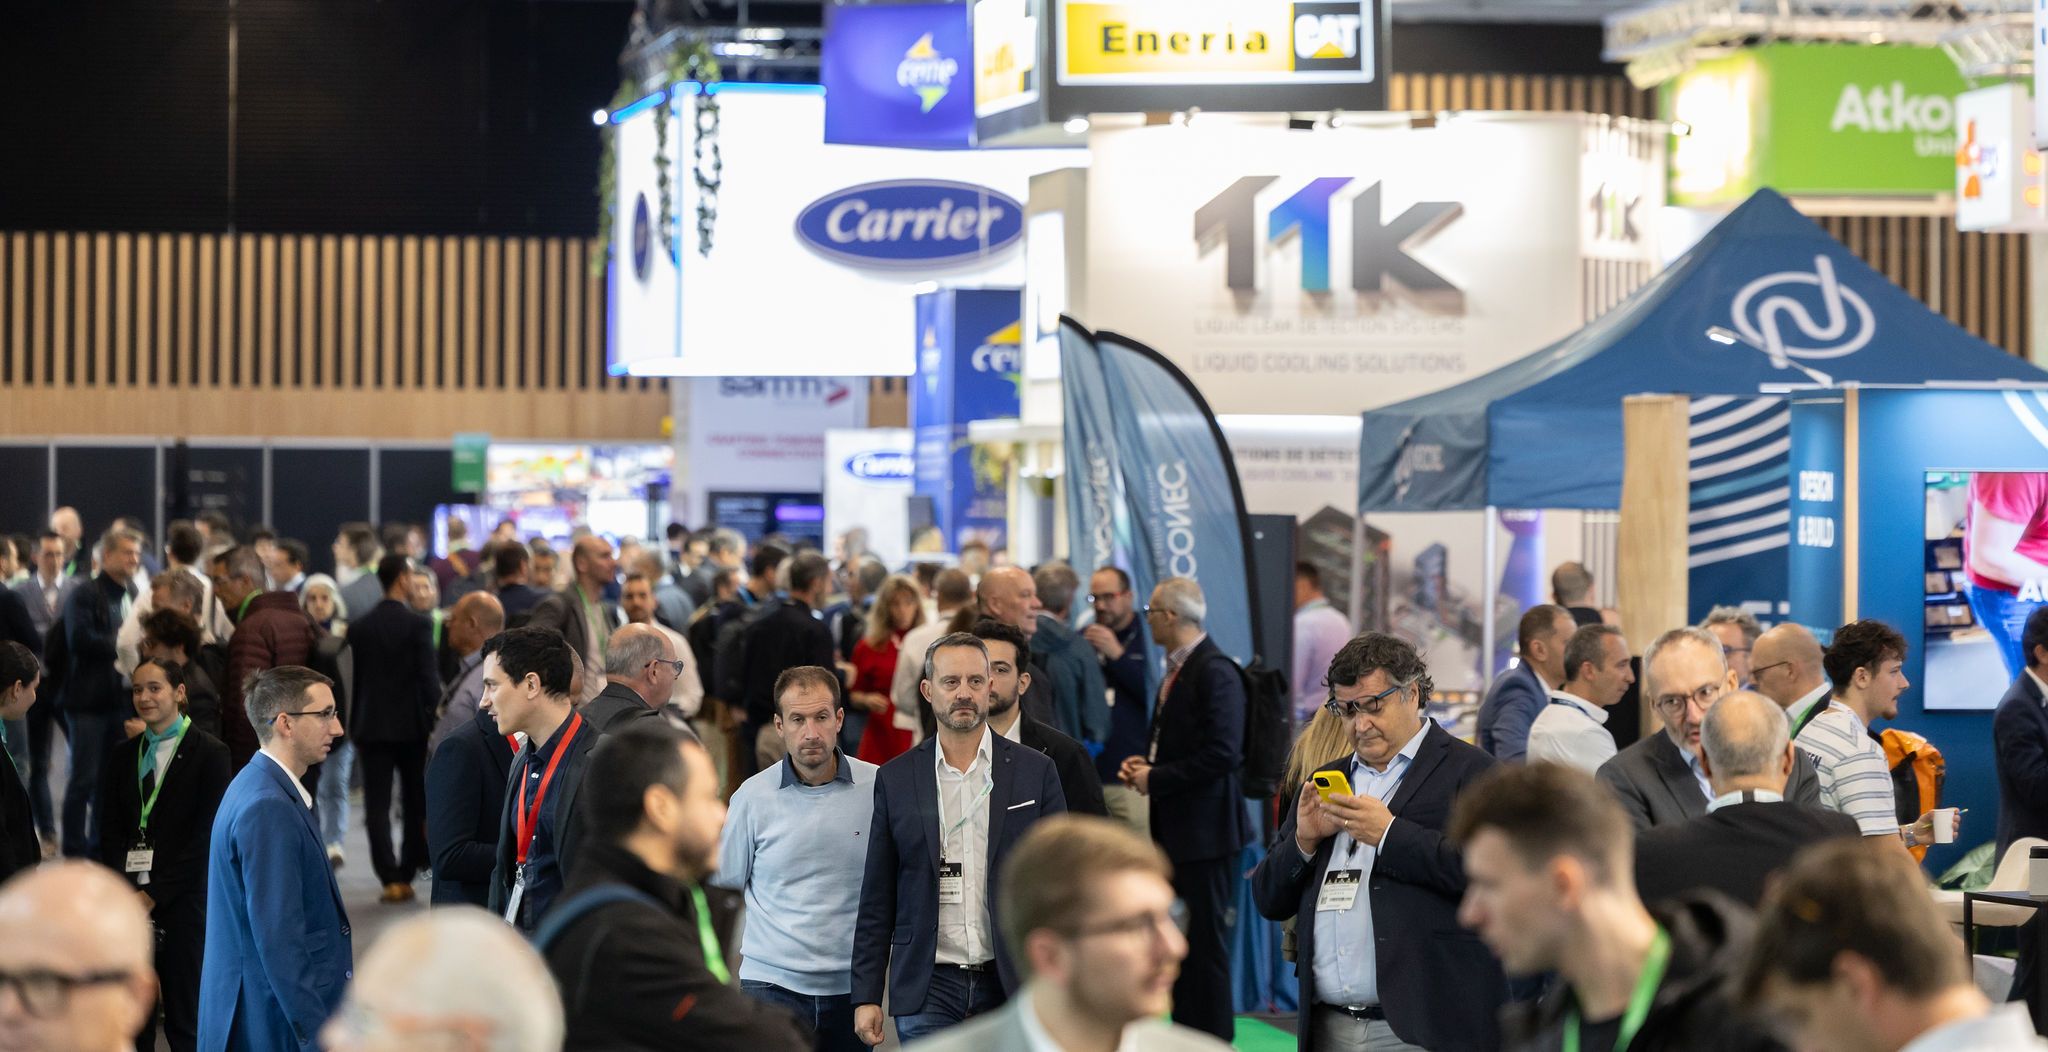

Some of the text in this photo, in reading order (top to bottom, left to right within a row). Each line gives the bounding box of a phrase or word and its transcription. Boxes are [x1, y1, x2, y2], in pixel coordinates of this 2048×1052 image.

[1102, 23, 1267, 53] Eneria
[1294, 14, 1360, 59] CAT
[1831, 81, 1954, 132] Atko
[825, 199, 1004, 244] Carrier
[1192, 353, 1466, 373] LIQUID COOLING SOLUTIONS
[1236, 448, 1280, 461] TIONS
[1156, 459, 1198, 582] CONEC
